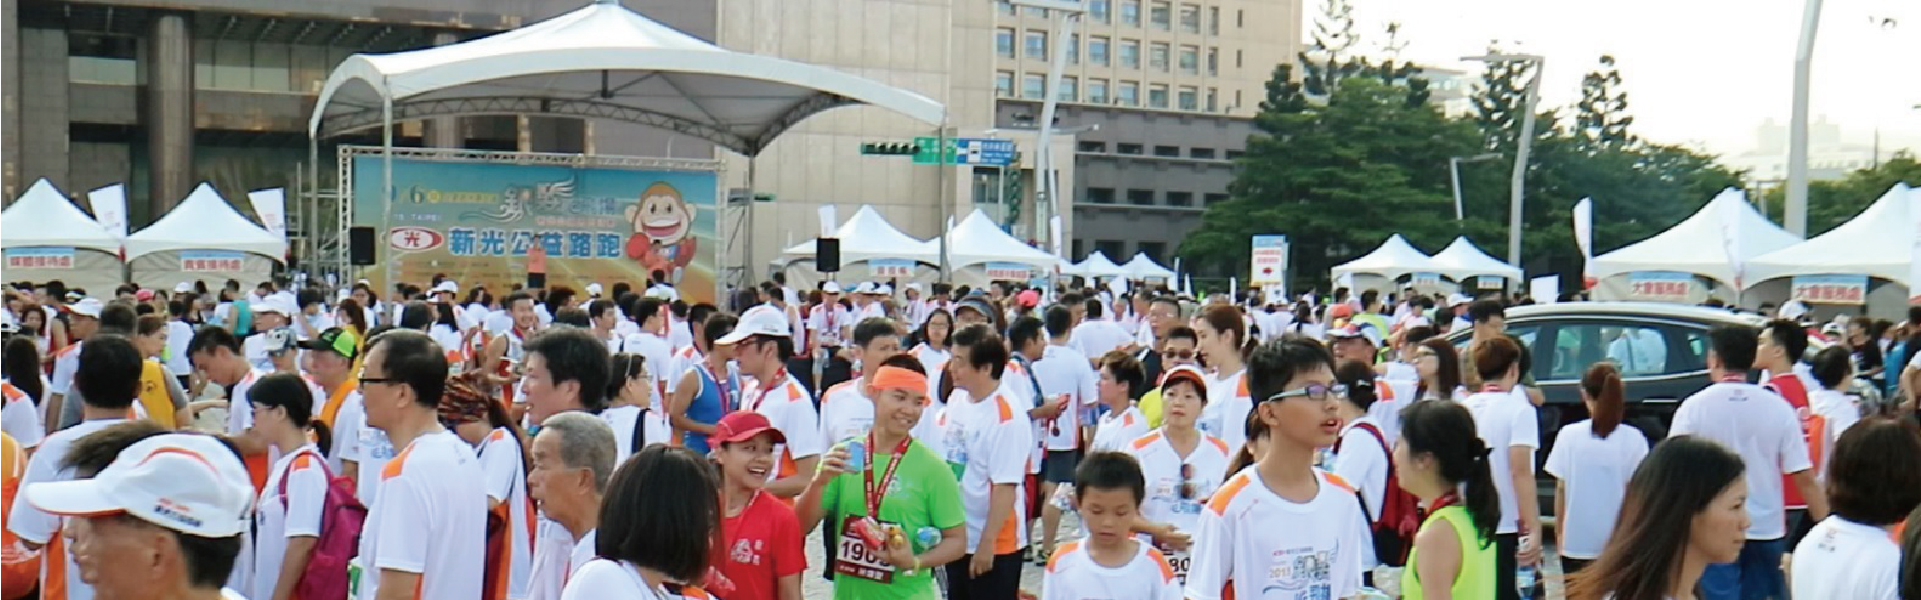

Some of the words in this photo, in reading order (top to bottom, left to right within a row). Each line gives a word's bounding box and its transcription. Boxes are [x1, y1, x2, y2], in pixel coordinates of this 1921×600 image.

[449, 228, 622, 257] 新光公益路跑
